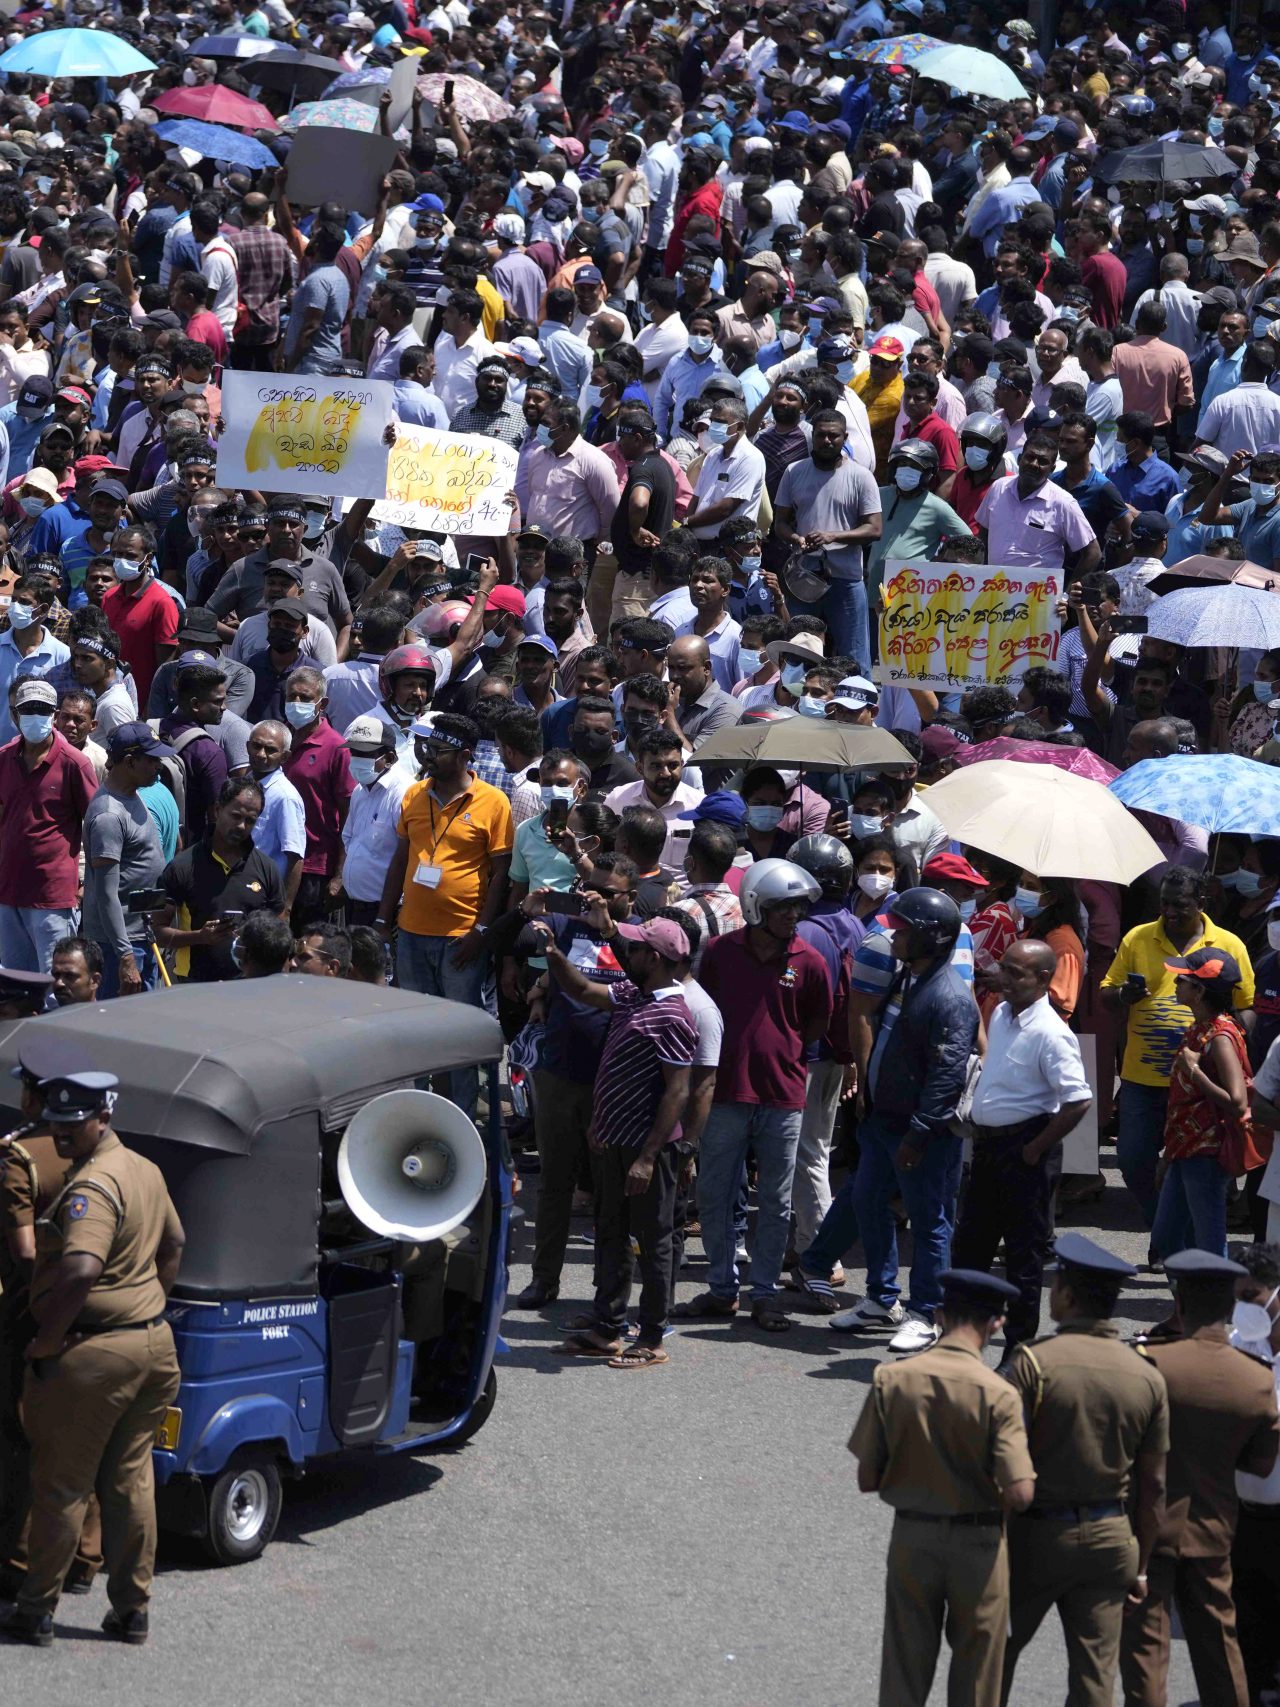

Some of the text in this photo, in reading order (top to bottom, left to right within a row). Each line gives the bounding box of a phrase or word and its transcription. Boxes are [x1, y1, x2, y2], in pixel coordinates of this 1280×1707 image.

[25, 392, 39, 405] CAT
[432, 439, 485, 461] Loan
[851, 690, 868, 701] TAX
[446, 735, 463, 748] TAX
[957, 731, 971, 744] TAX
[243, 1301, 319, 1323] POLICE STATION
[262, 1325, 291, 1341] FORT
